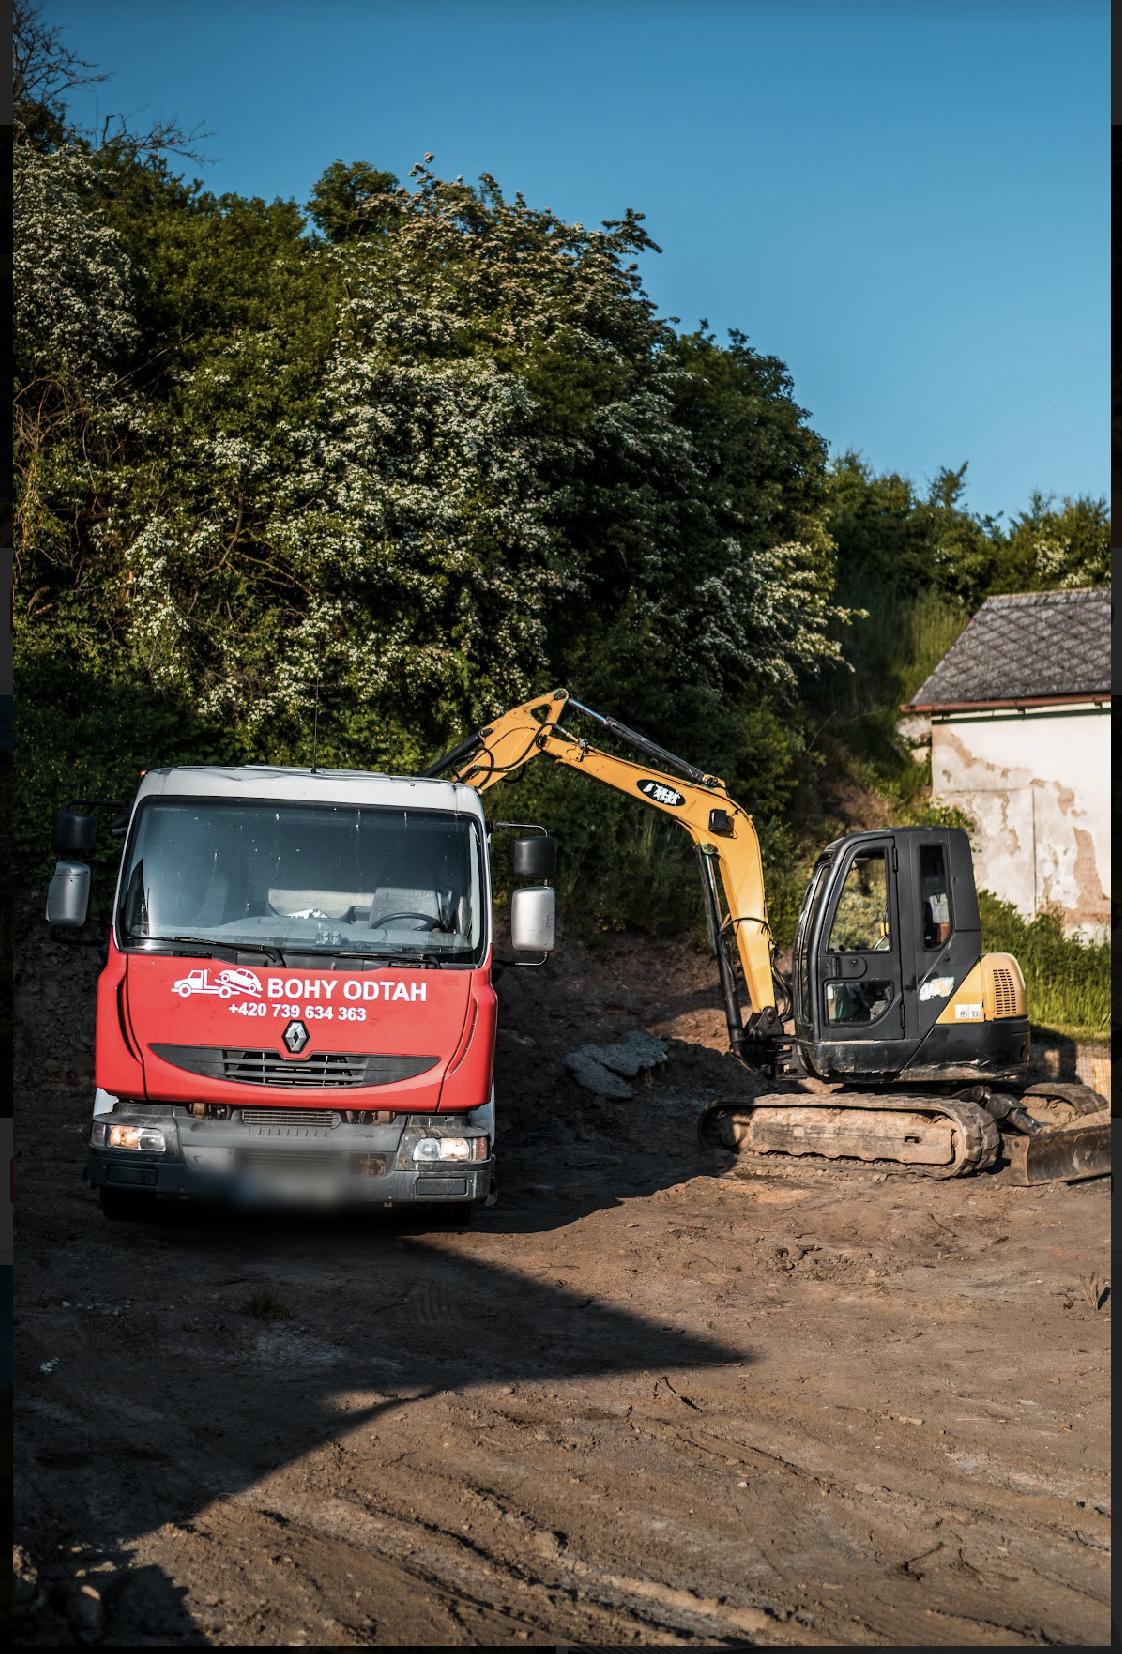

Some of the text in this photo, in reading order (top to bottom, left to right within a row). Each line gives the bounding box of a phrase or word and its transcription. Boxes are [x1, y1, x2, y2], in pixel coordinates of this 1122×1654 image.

[267, 978, 428, 1001] BOHY ODTAH
[228, 1002, 367, 1021] +420 739 634 363
